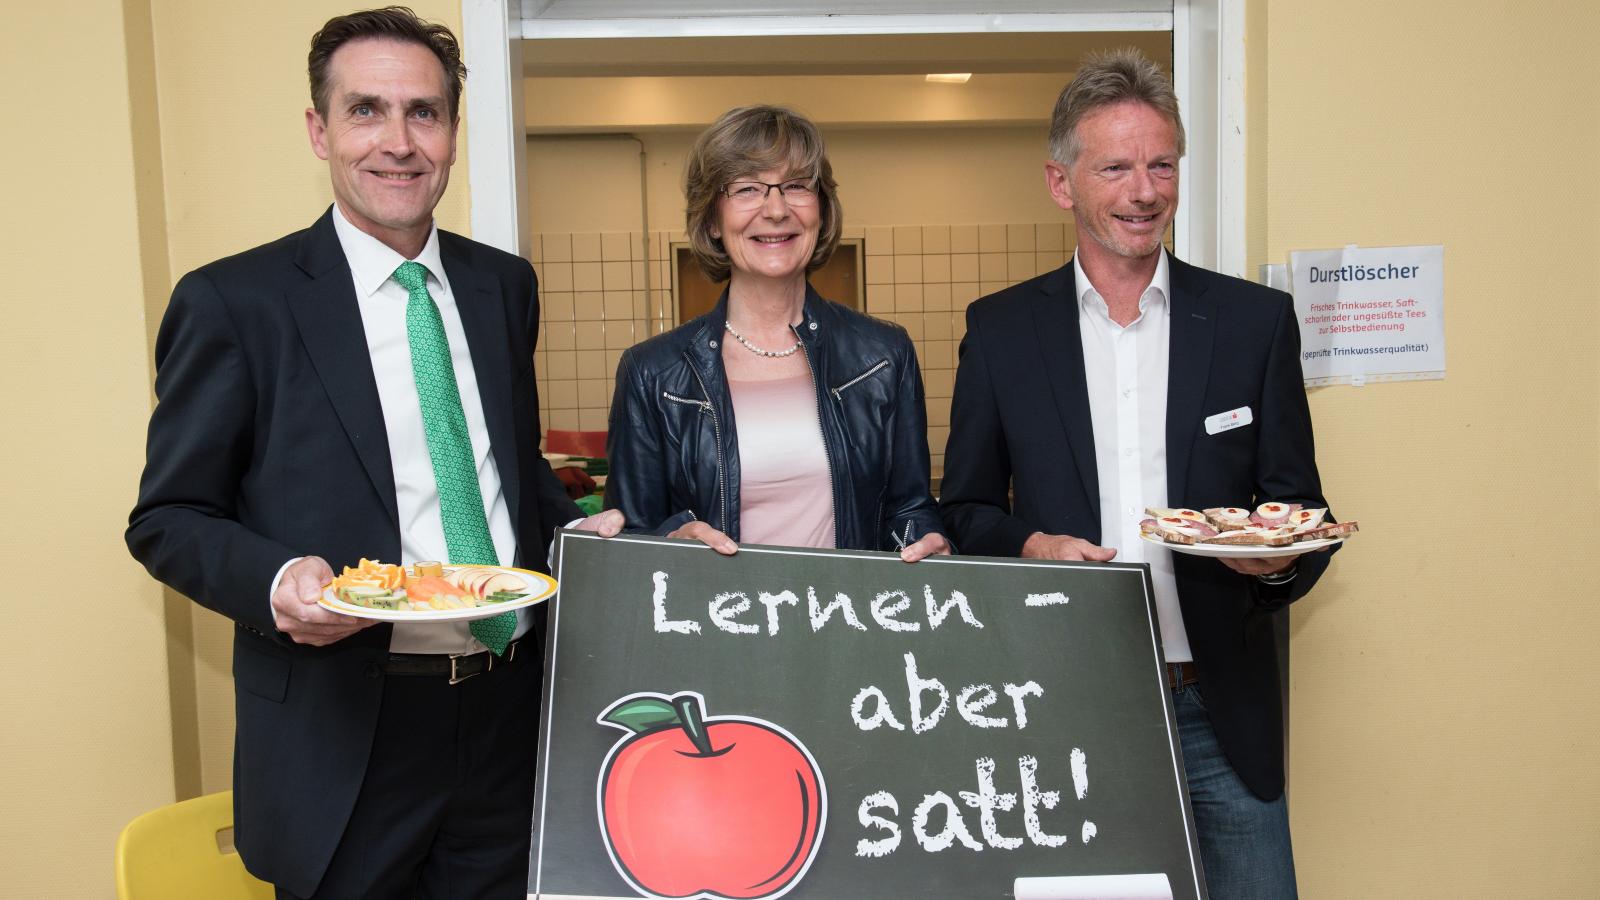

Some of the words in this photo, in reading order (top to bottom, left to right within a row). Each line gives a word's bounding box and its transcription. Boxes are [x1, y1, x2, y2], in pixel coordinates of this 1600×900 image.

[1309, 263, 1420, 283] Durstlöscher
[1310, 303, 1336, 312] Frisches
[1337, 300, 1393, 310] Trinkwasser,
[1396, 298, 1419, 308] Saft-
[1331, 314, 1351, 322] oder
[1353, 311, 1403, 322] ungesüßte
[1406, 310, 1426, 318] Tees
[1319, 327, 1329, 335] zur
[1329, 323, 1405, 334] Selbstbedienung
[1303, 348, 1332, 361] (geprüfte
[1333, 343, 1429, 356] Trinkwasserqualität)
[652, 570, 985, 637] Lernen
[850, 651, 1045, 735] aber
[855, 747, 1098, 858] satt!
